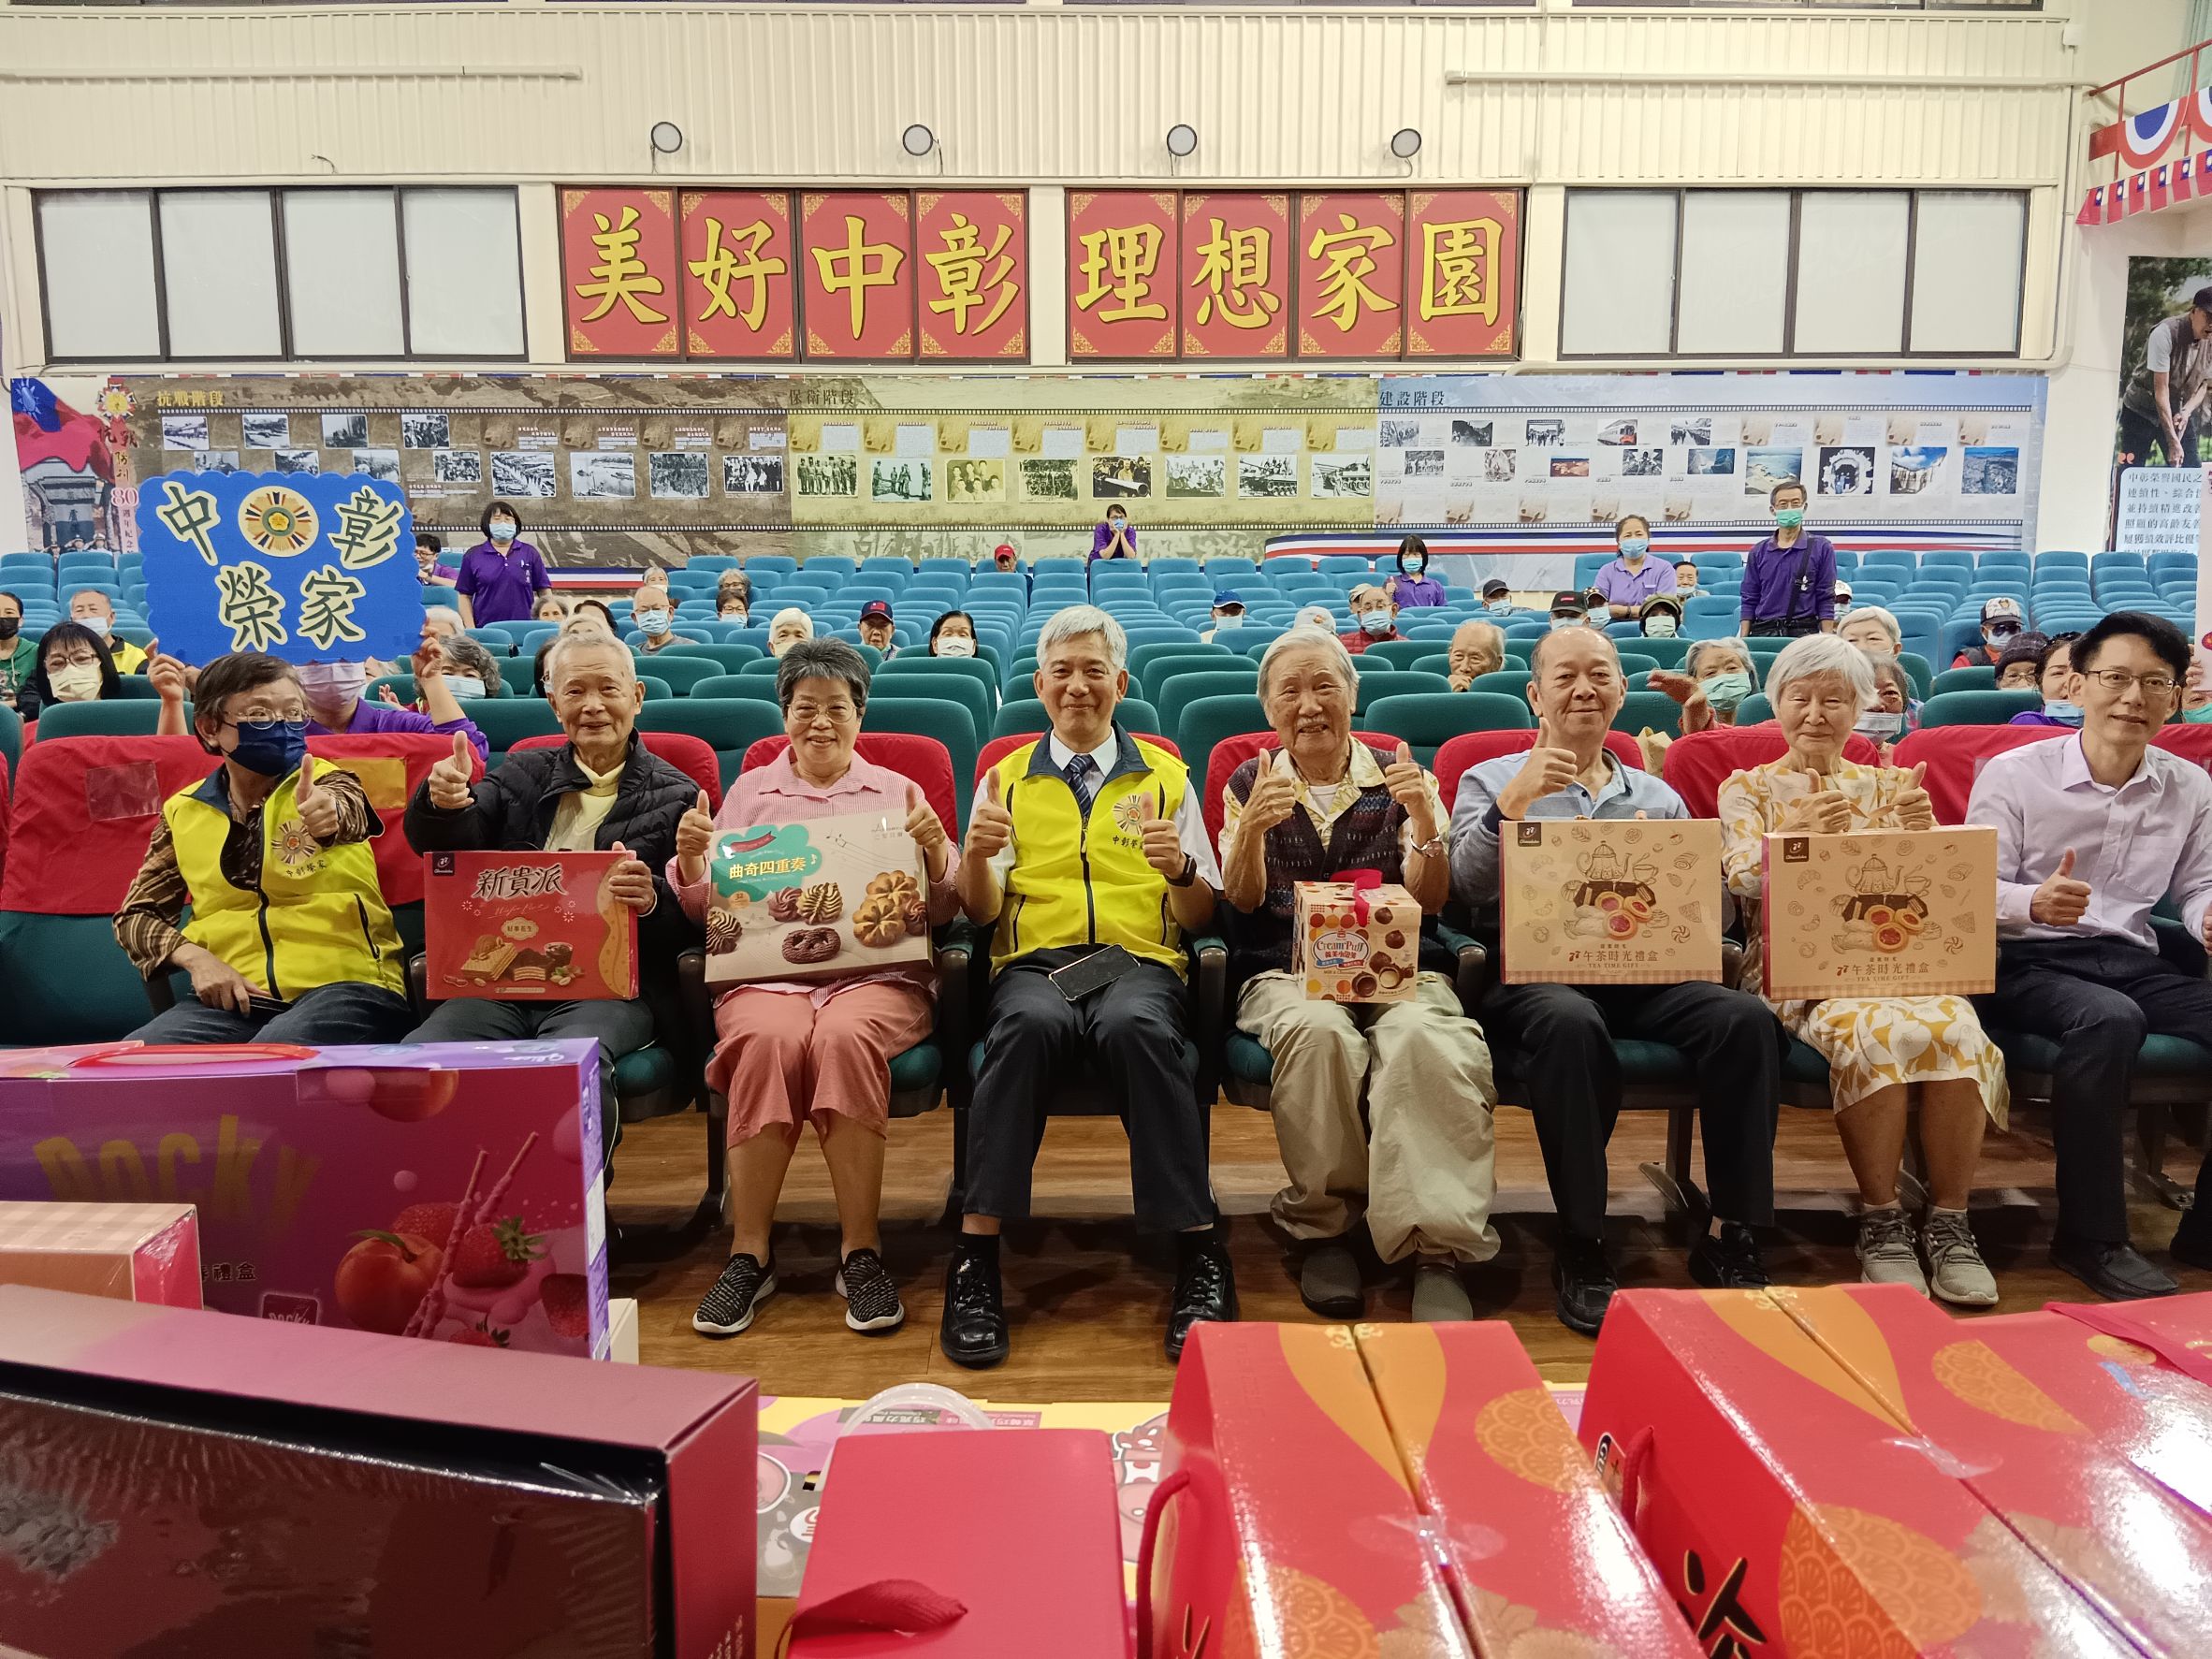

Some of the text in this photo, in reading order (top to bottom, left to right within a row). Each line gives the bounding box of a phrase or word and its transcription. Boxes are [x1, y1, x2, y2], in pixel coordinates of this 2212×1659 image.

[575, 206, 1505, 340] 美好中彰 理想家園
[789, 388, 856, 407] 保衛階段
[1379, 390, 1446, 406] 建設階段
[111, 488, 138, 506] 80
[159, 484, 401, 566] 中 彰
[220, 564, 363, 649] 榮家
[1112, 836, 1143, 851] 中彰榮
[729, 857, 807, 880] 曲奇四重奏
[472, 862, 569, 901] 新貴派
